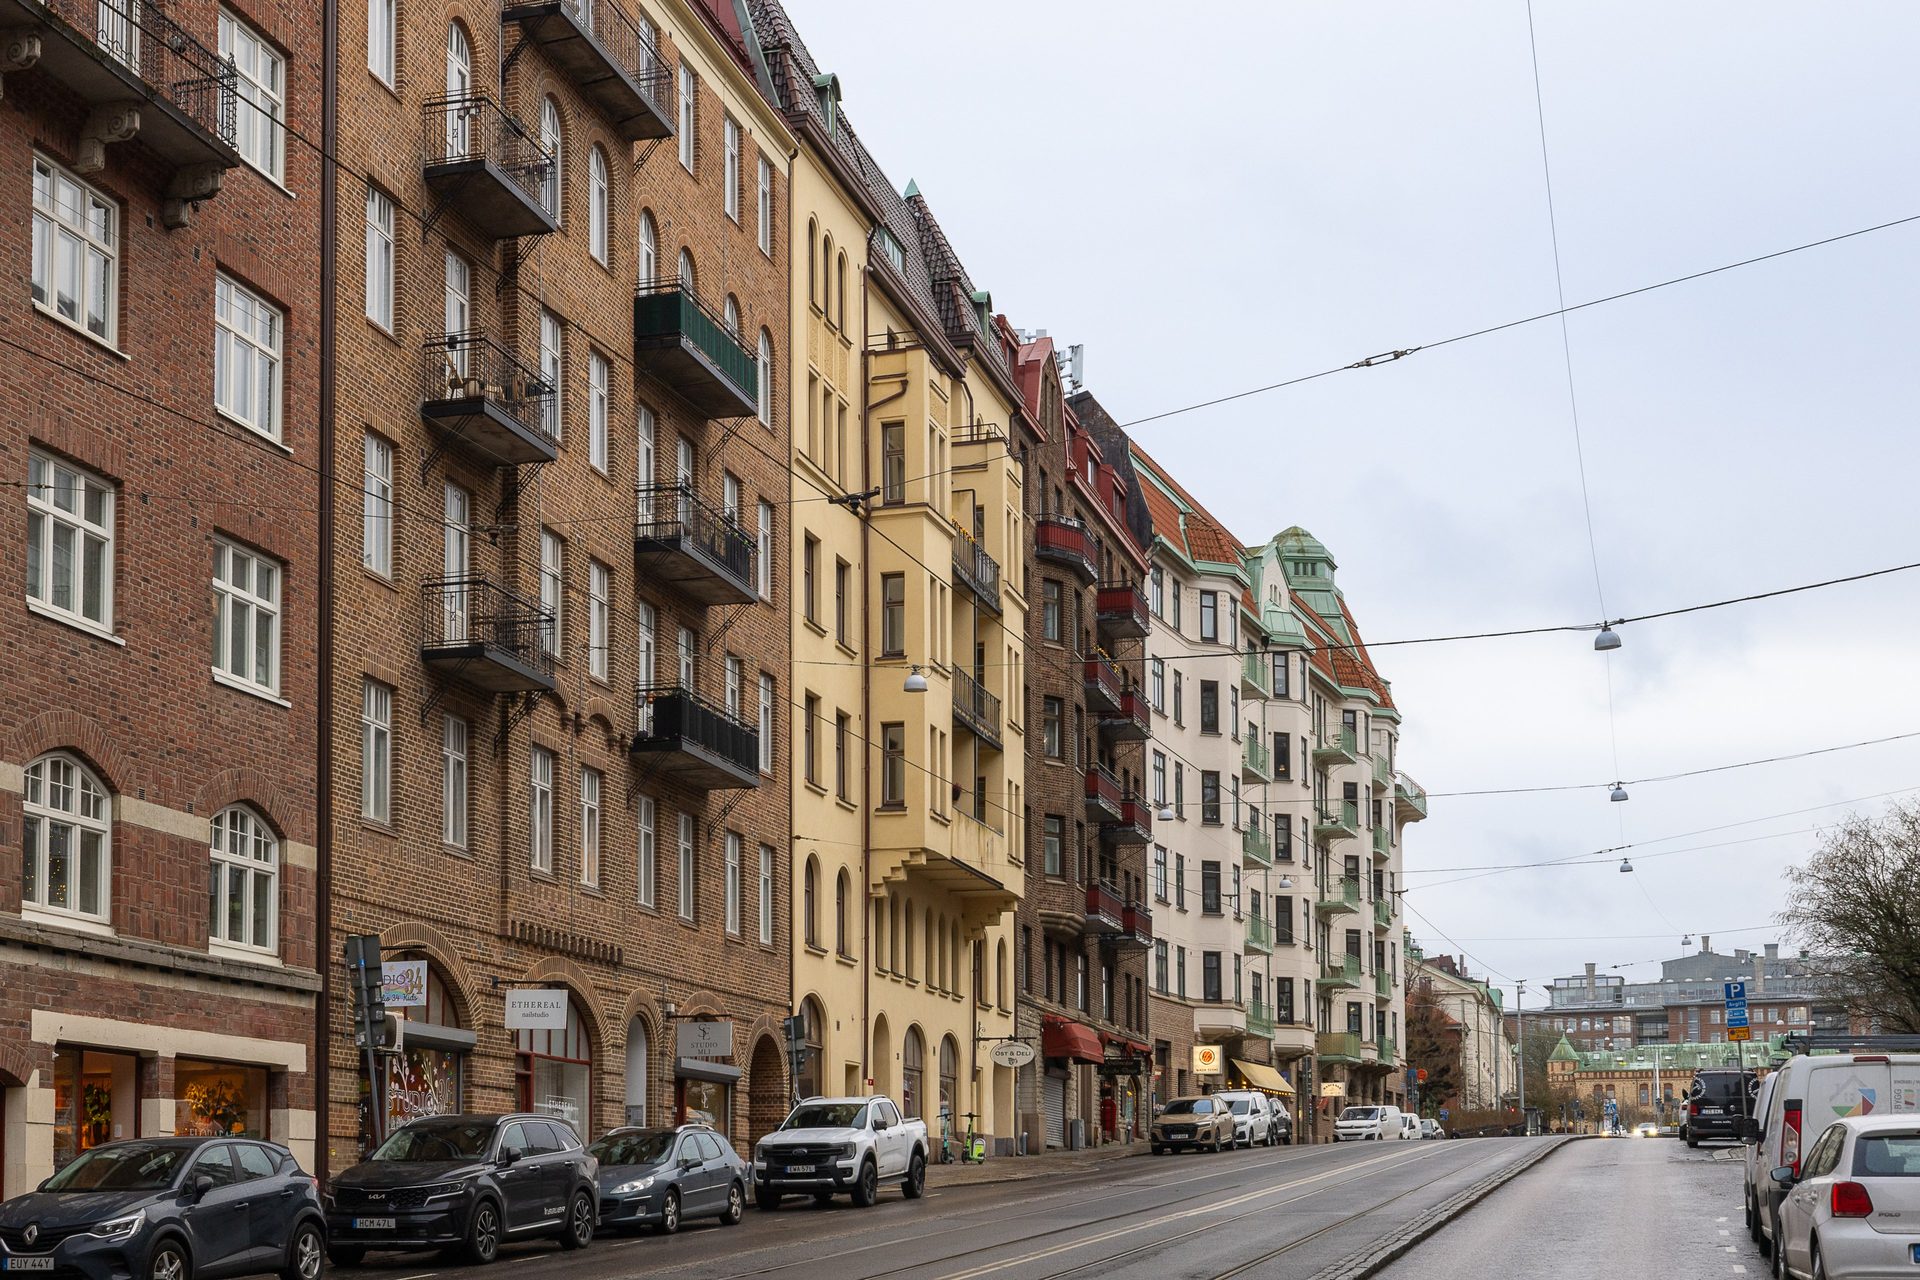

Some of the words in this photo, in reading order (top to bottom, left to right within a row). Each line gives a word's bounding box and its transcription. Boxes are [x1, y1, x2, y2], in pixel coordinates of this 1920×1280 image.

[383, 975, 405, 985] DIO
[404, 966, 423, 995] 34
[1730, 983, 1741, 998] P
[511, 1001, 561, 1009] ETHEREAL
[1893, 1088, 1903, 1110] BYGG
[10, 1258, 29, 1269] EUY
[31, 1258, 50, 1269] 44Y
